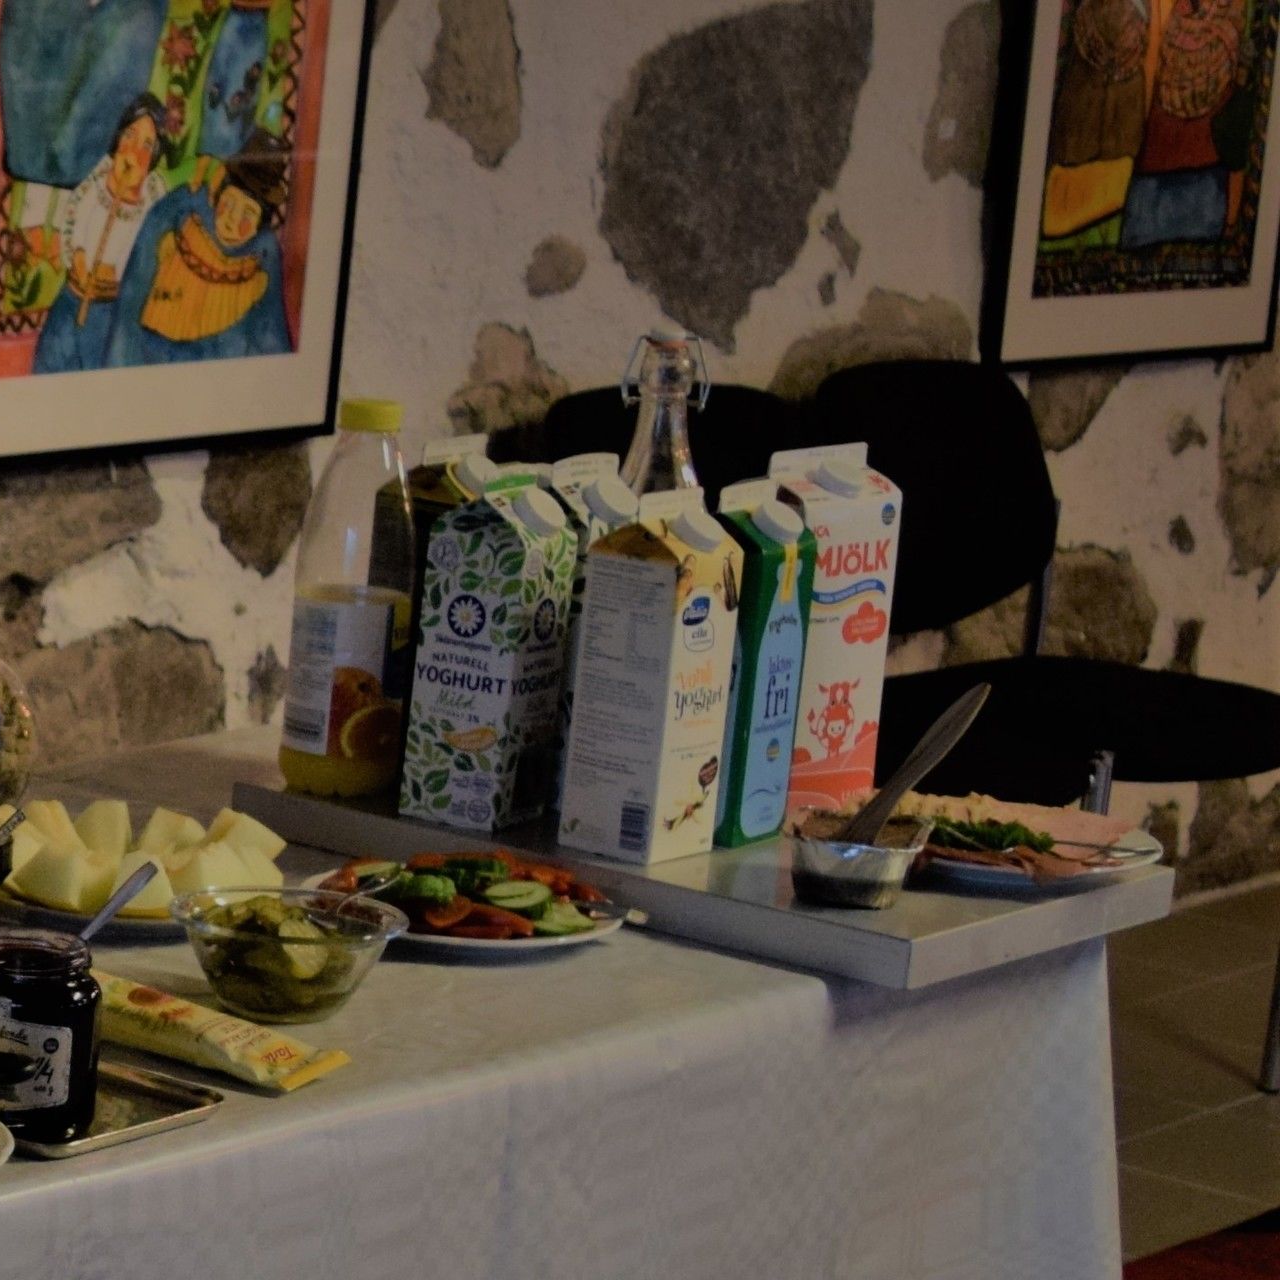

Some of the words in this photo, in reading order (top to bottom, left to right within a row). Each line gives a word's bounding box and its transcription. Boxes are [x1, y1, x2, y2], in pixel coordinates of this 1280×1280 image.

[416, 662, 507, 695] YOGHURT
[432, 652, 490, 673] NATURELL
[764, 673, 791, 719] fri
